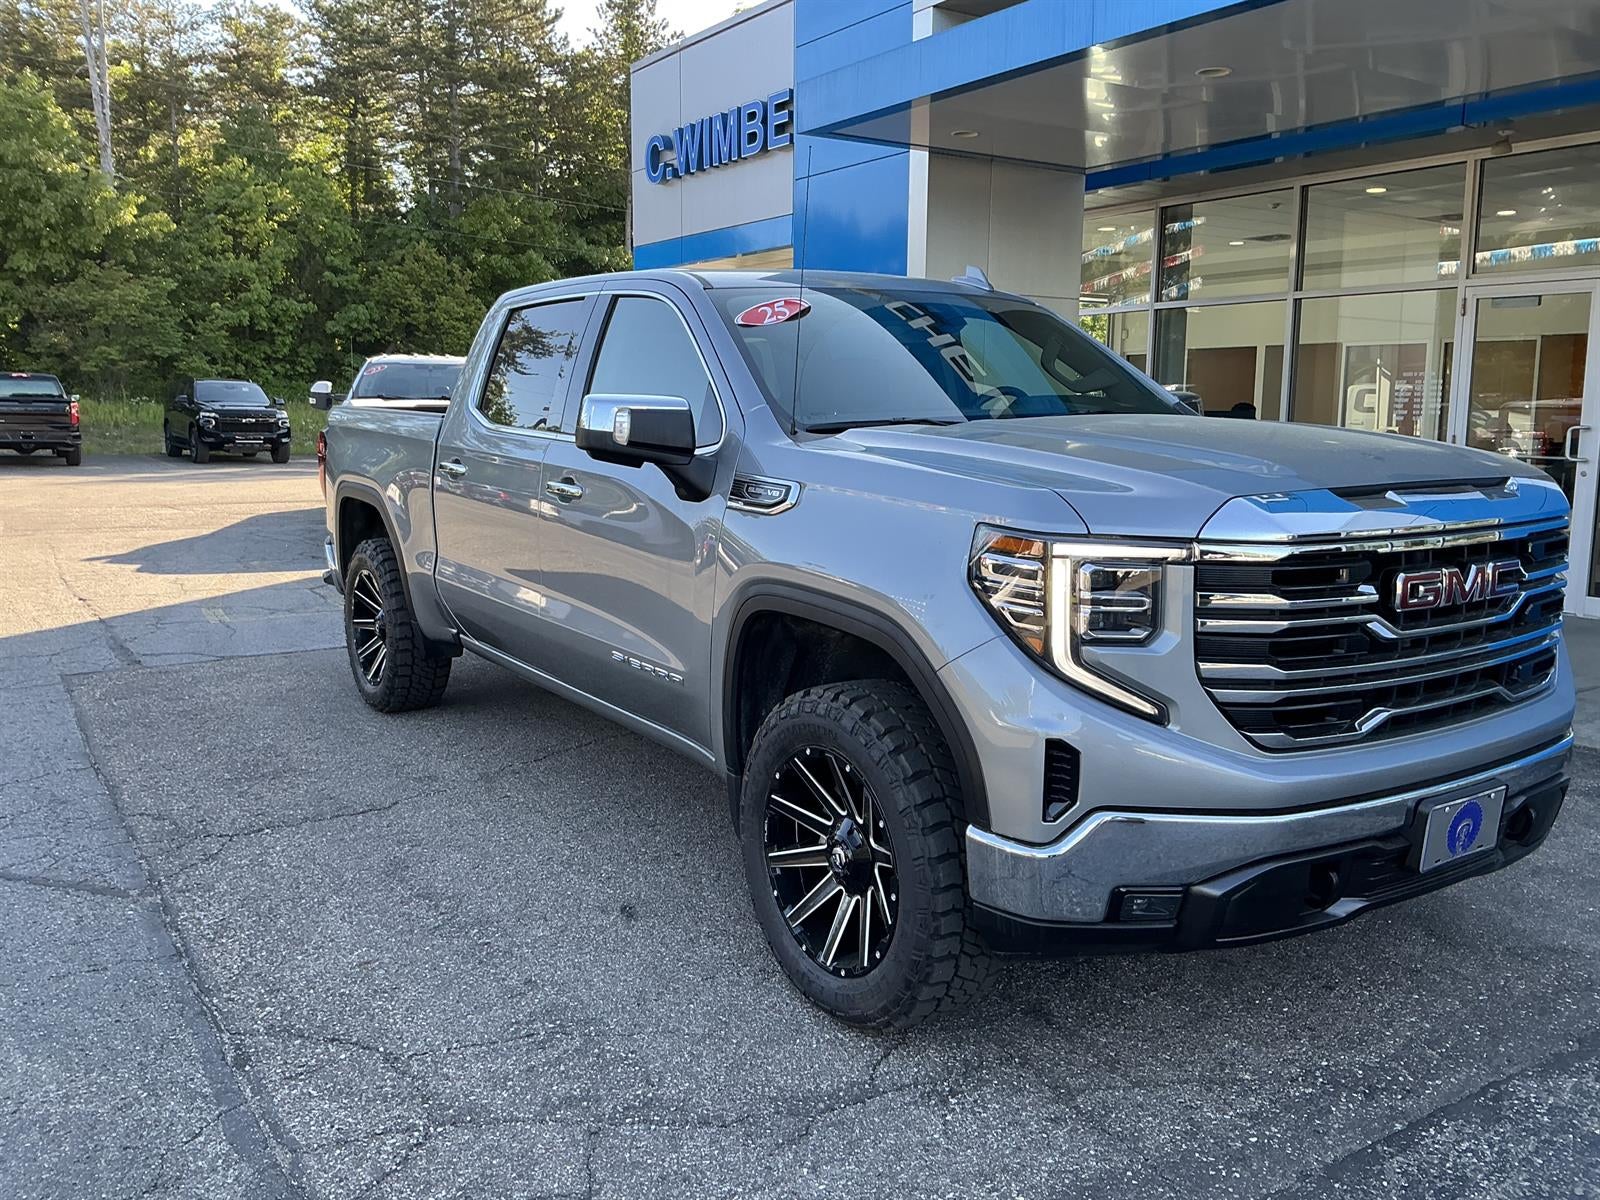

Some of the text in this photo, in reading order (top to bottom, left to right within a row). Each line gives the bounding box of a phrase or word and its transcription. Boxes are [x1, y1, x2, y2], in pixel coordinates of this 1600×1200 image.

[645, 88, 795, 185] C.WIMBE
[758, 300, 790, 325] 25
[1395, 559, 1522, 612] GMC
[611, 650, 684, 686] SIERRA
